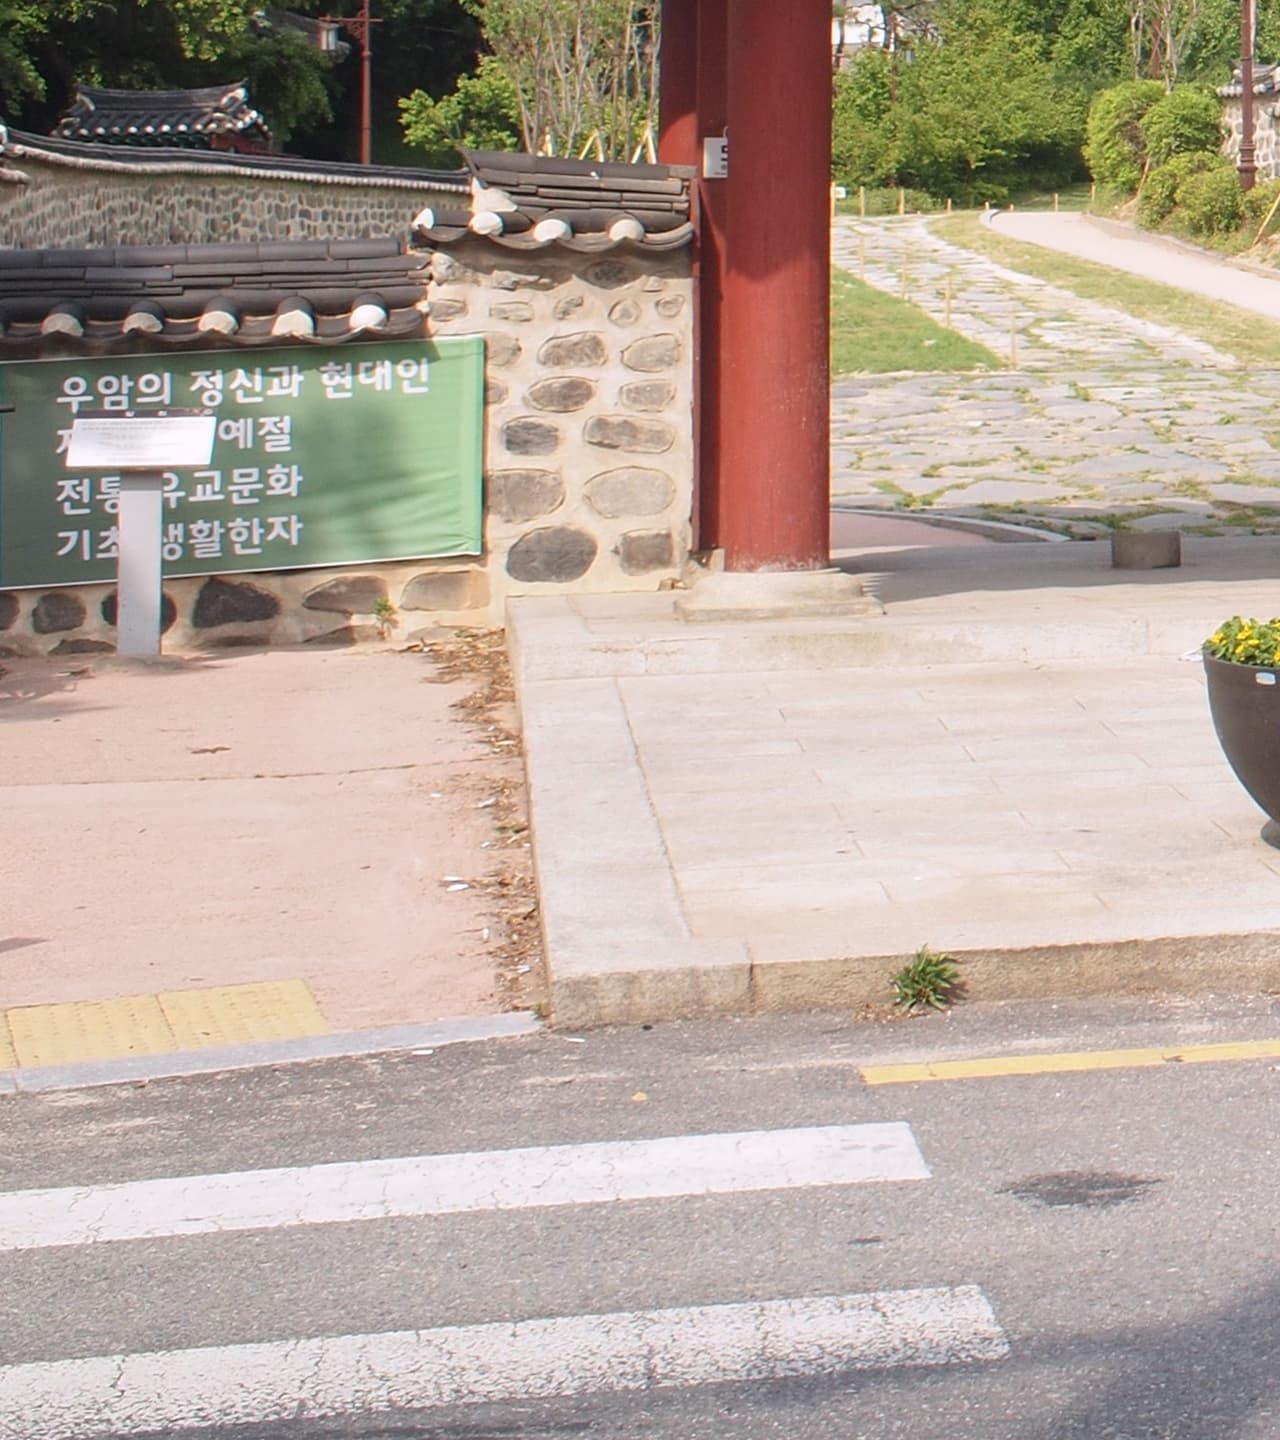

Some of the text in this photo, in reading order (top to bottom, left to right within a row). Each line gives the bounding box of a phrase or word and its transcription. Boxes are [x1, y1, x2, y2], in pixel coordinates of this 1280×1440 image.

[55, 358, 430, 413] 우암의 정신과 현대인
